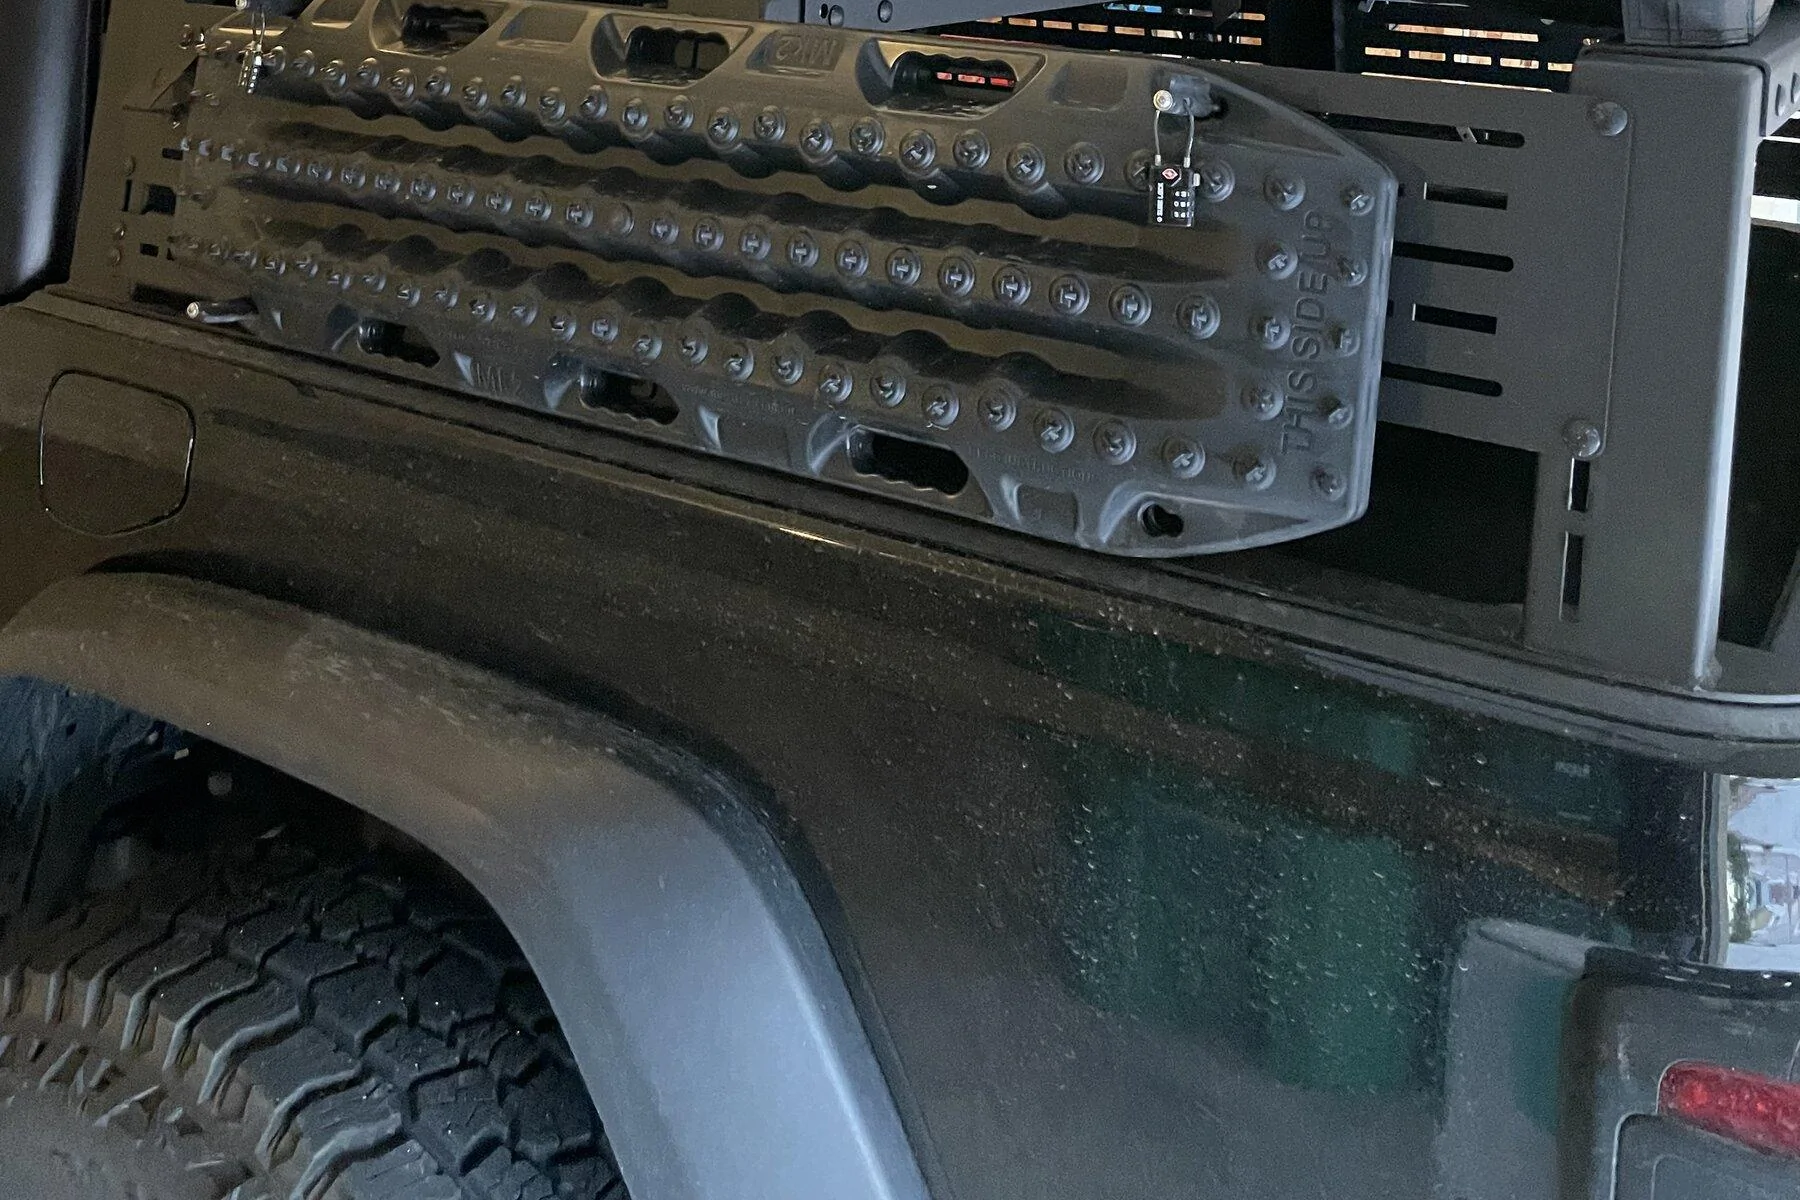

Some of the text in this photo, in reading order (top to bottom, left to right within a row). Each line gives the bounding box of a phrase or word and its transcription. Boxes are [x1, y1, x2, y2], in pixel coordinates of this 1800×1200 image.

[1280, 209, 1332, 455] THIS SIDE UP
